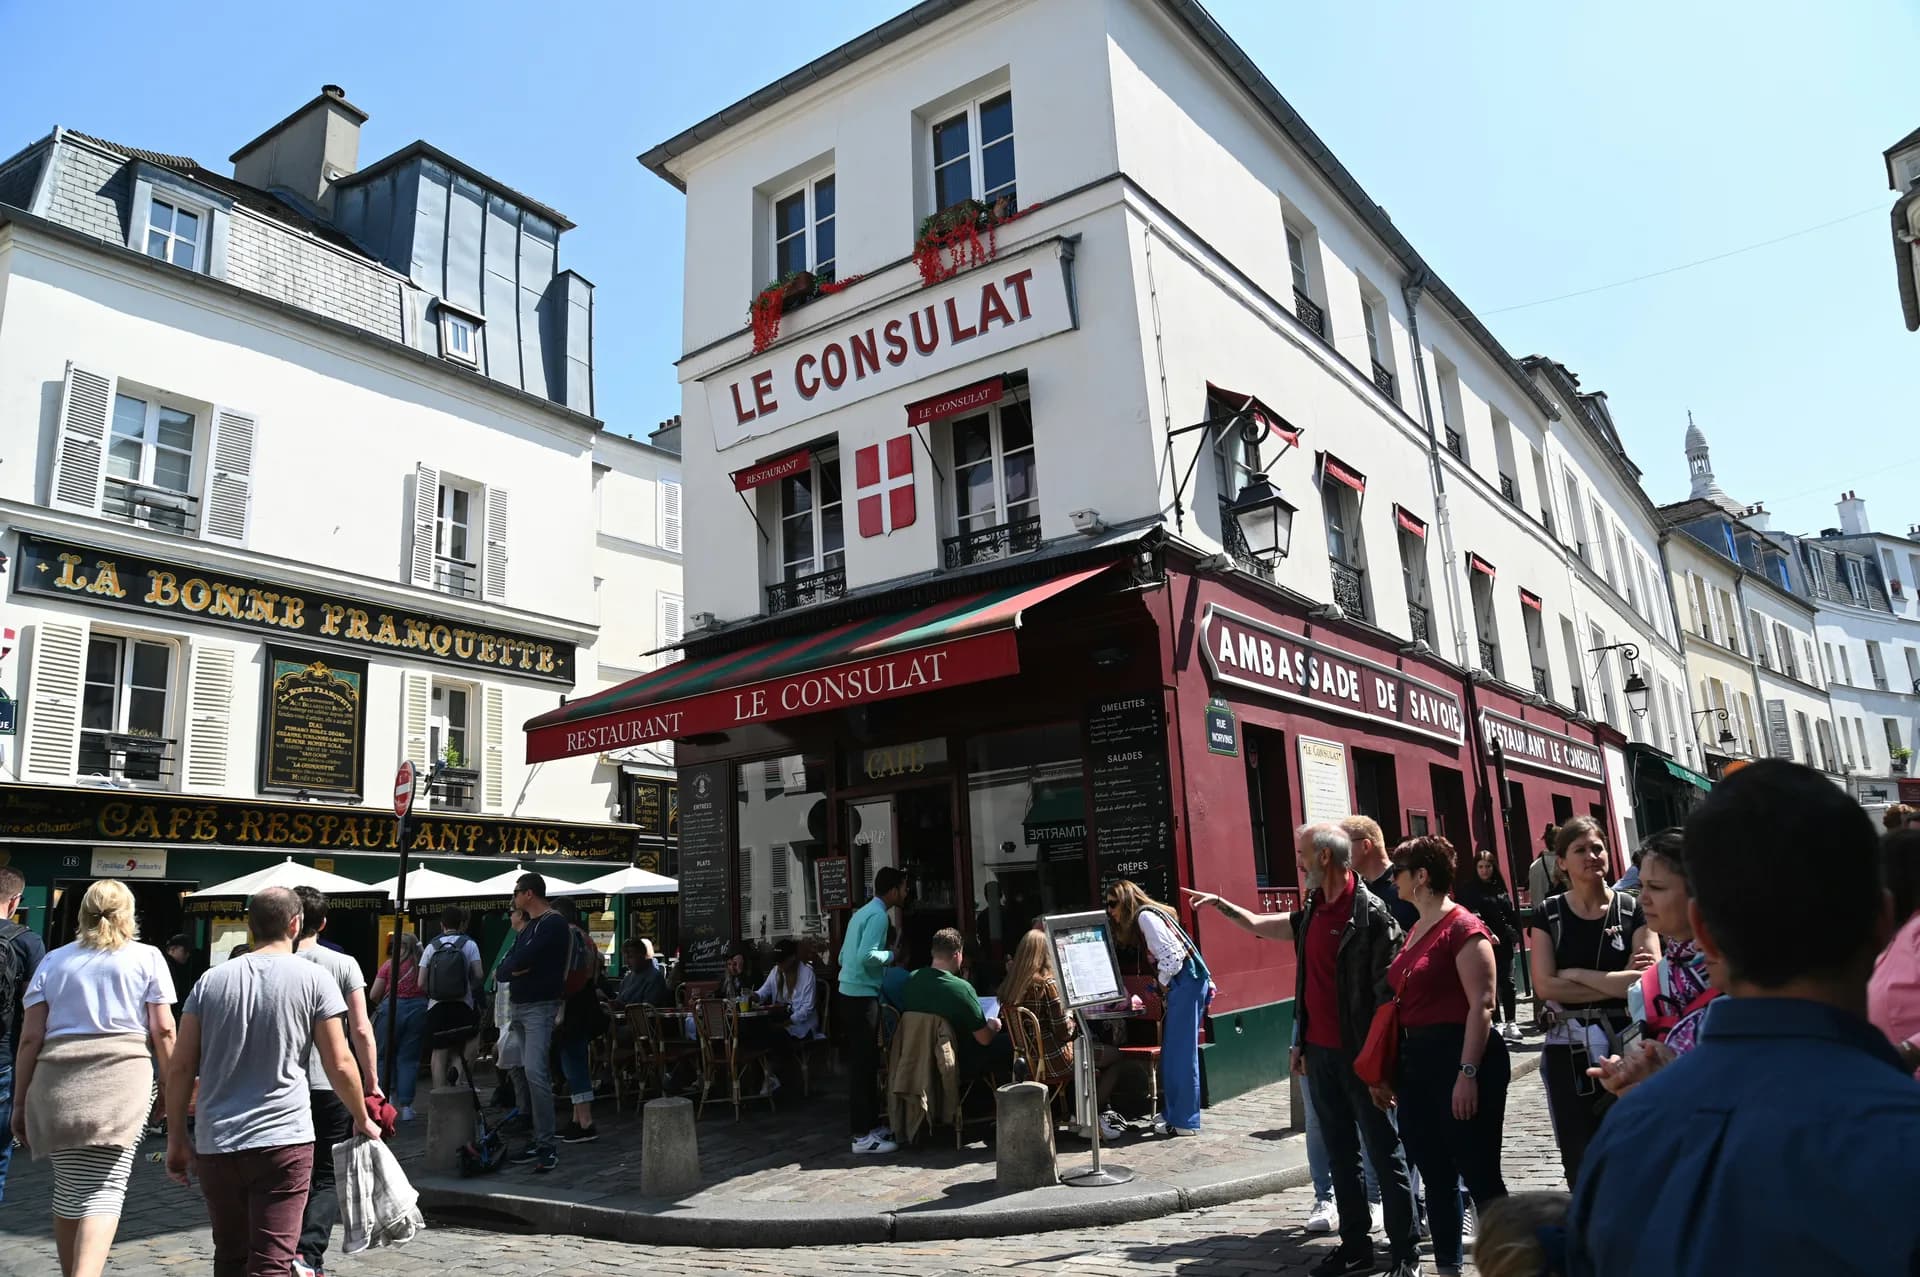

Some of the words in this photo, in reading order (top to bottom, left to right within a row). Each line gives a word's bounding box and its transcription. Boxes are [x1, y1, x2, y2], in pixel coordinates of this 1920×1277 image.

[730, 369, 778, 426] LE
[795, 268, 1033, 401] CONSULAT
[918, 407, 932, 419] LE
[935, 388, 991, 415] CONSULAT
[746, 459, 799, 485] RESTAURANT
[54, 552, 127, 598] LA
[144, 569, 305, 629] BONNE
[320, 603, 554, 673] FRANQUETTE
[1219, 626, 1360, 703] AMBASSADE
[1375, 678, 1397, 713] DE
[1410, 689, 1460, 733] SAVOIE
[566, 711, 683, 752] RESTAURANT
[734, 689, 769, 721] LE
[781, 652, 947, 711] CONSULAT
[1101, 698, 1145, 713] OMELETTES
[1215, 718, 1227, 729] RUE
[1107, 751, 1143, 763] SALADES
[1484, 719, 1547, 760] RESTAURANT
[1550, 740, 1561, 764] LE
[98, 802, 219, 841] CAFÉ
[498, 826, 560, 855] VINS
[66, 857, 77, 865] 18
[325, 897, 382, 910] RANQUETTE
